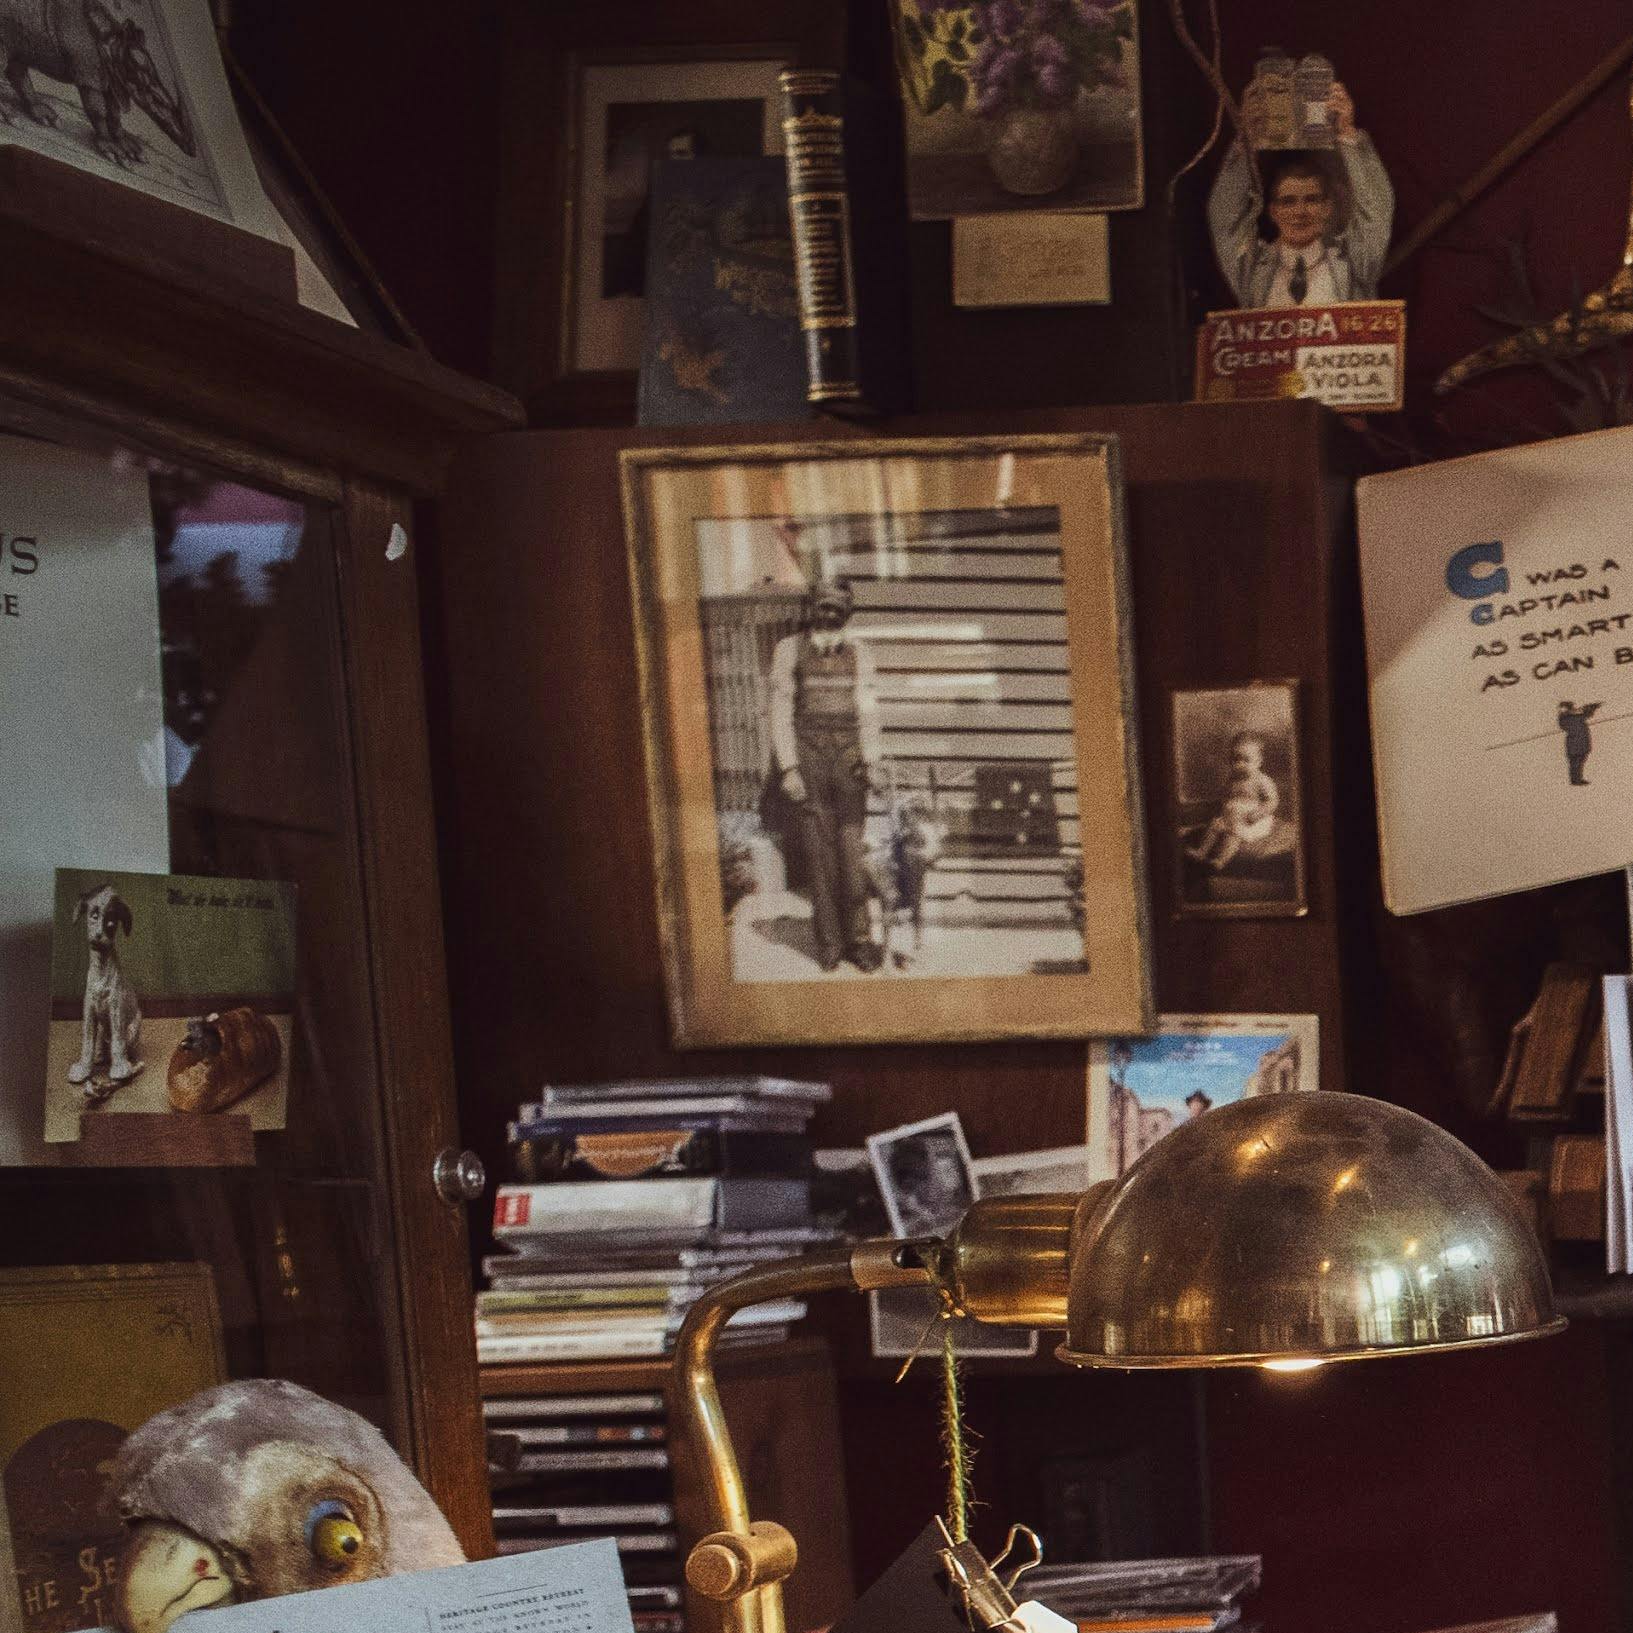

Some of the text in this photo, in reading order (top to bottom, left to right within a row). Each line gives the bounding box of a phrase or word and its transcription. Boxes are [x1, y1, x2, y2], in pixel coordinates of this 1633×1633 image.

[1210, 311, 1340, 350] ANZORA
[1213, 347, 1291, 376] CREAM
[1305, 353, 1393, 369] ANZORA
[1313, 373, 1383, 389] VIOLA
[1446, 540, 1621, 600] C WAS A
[1469, 585, 1611, 627] CAPTAIN
[1472, 613, 1633, 660] AS SMART
[1481, 668, 1522, 693] AS
[1532, 655, 1595, 681] CAN
